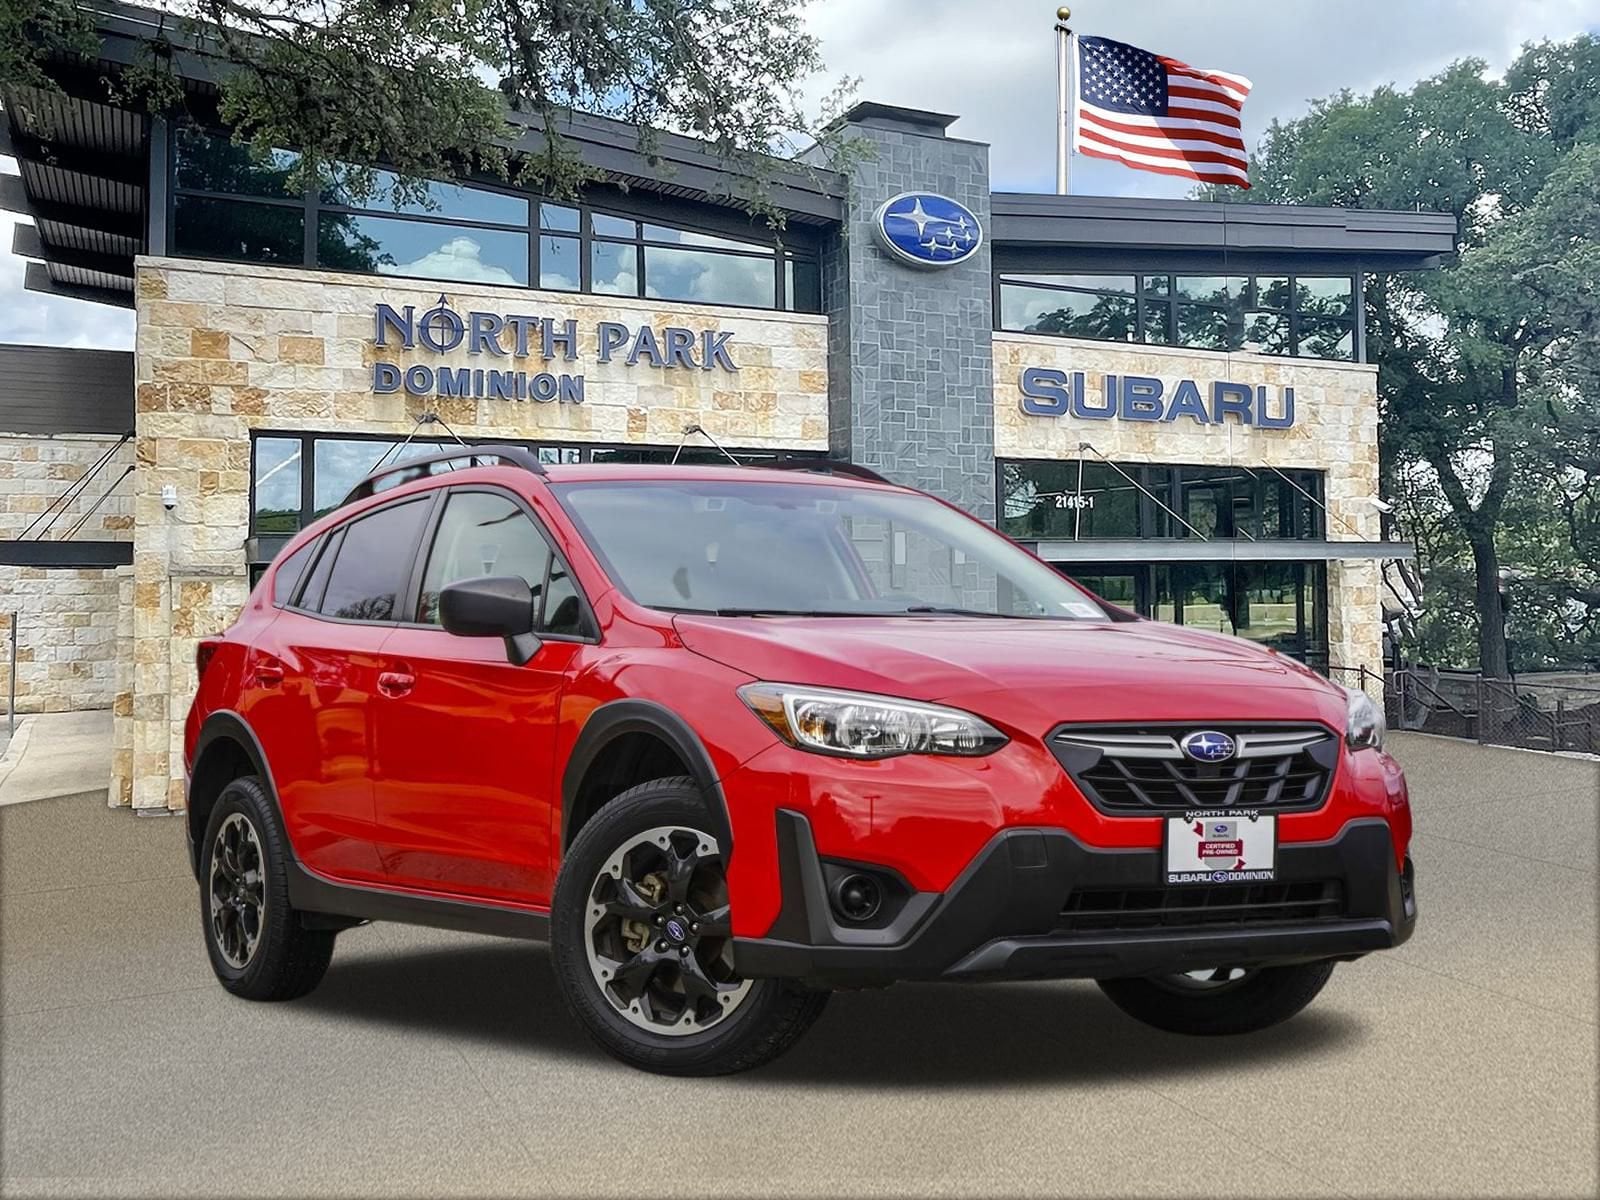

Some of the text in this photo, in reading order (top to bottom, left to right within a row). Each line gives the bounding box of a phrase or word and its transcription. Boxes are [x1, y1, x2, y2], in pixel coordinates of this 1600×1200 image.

[374, 293, 741, 372] NORTH PARK
[373, 363, 586, 404] DOMINION
[1019, 367, 1295, 429] SUBARU
[1185, 809, 1259, 818] NORTH PARK
[1168, 871, 1275, 883] SUBARU DOMINION
